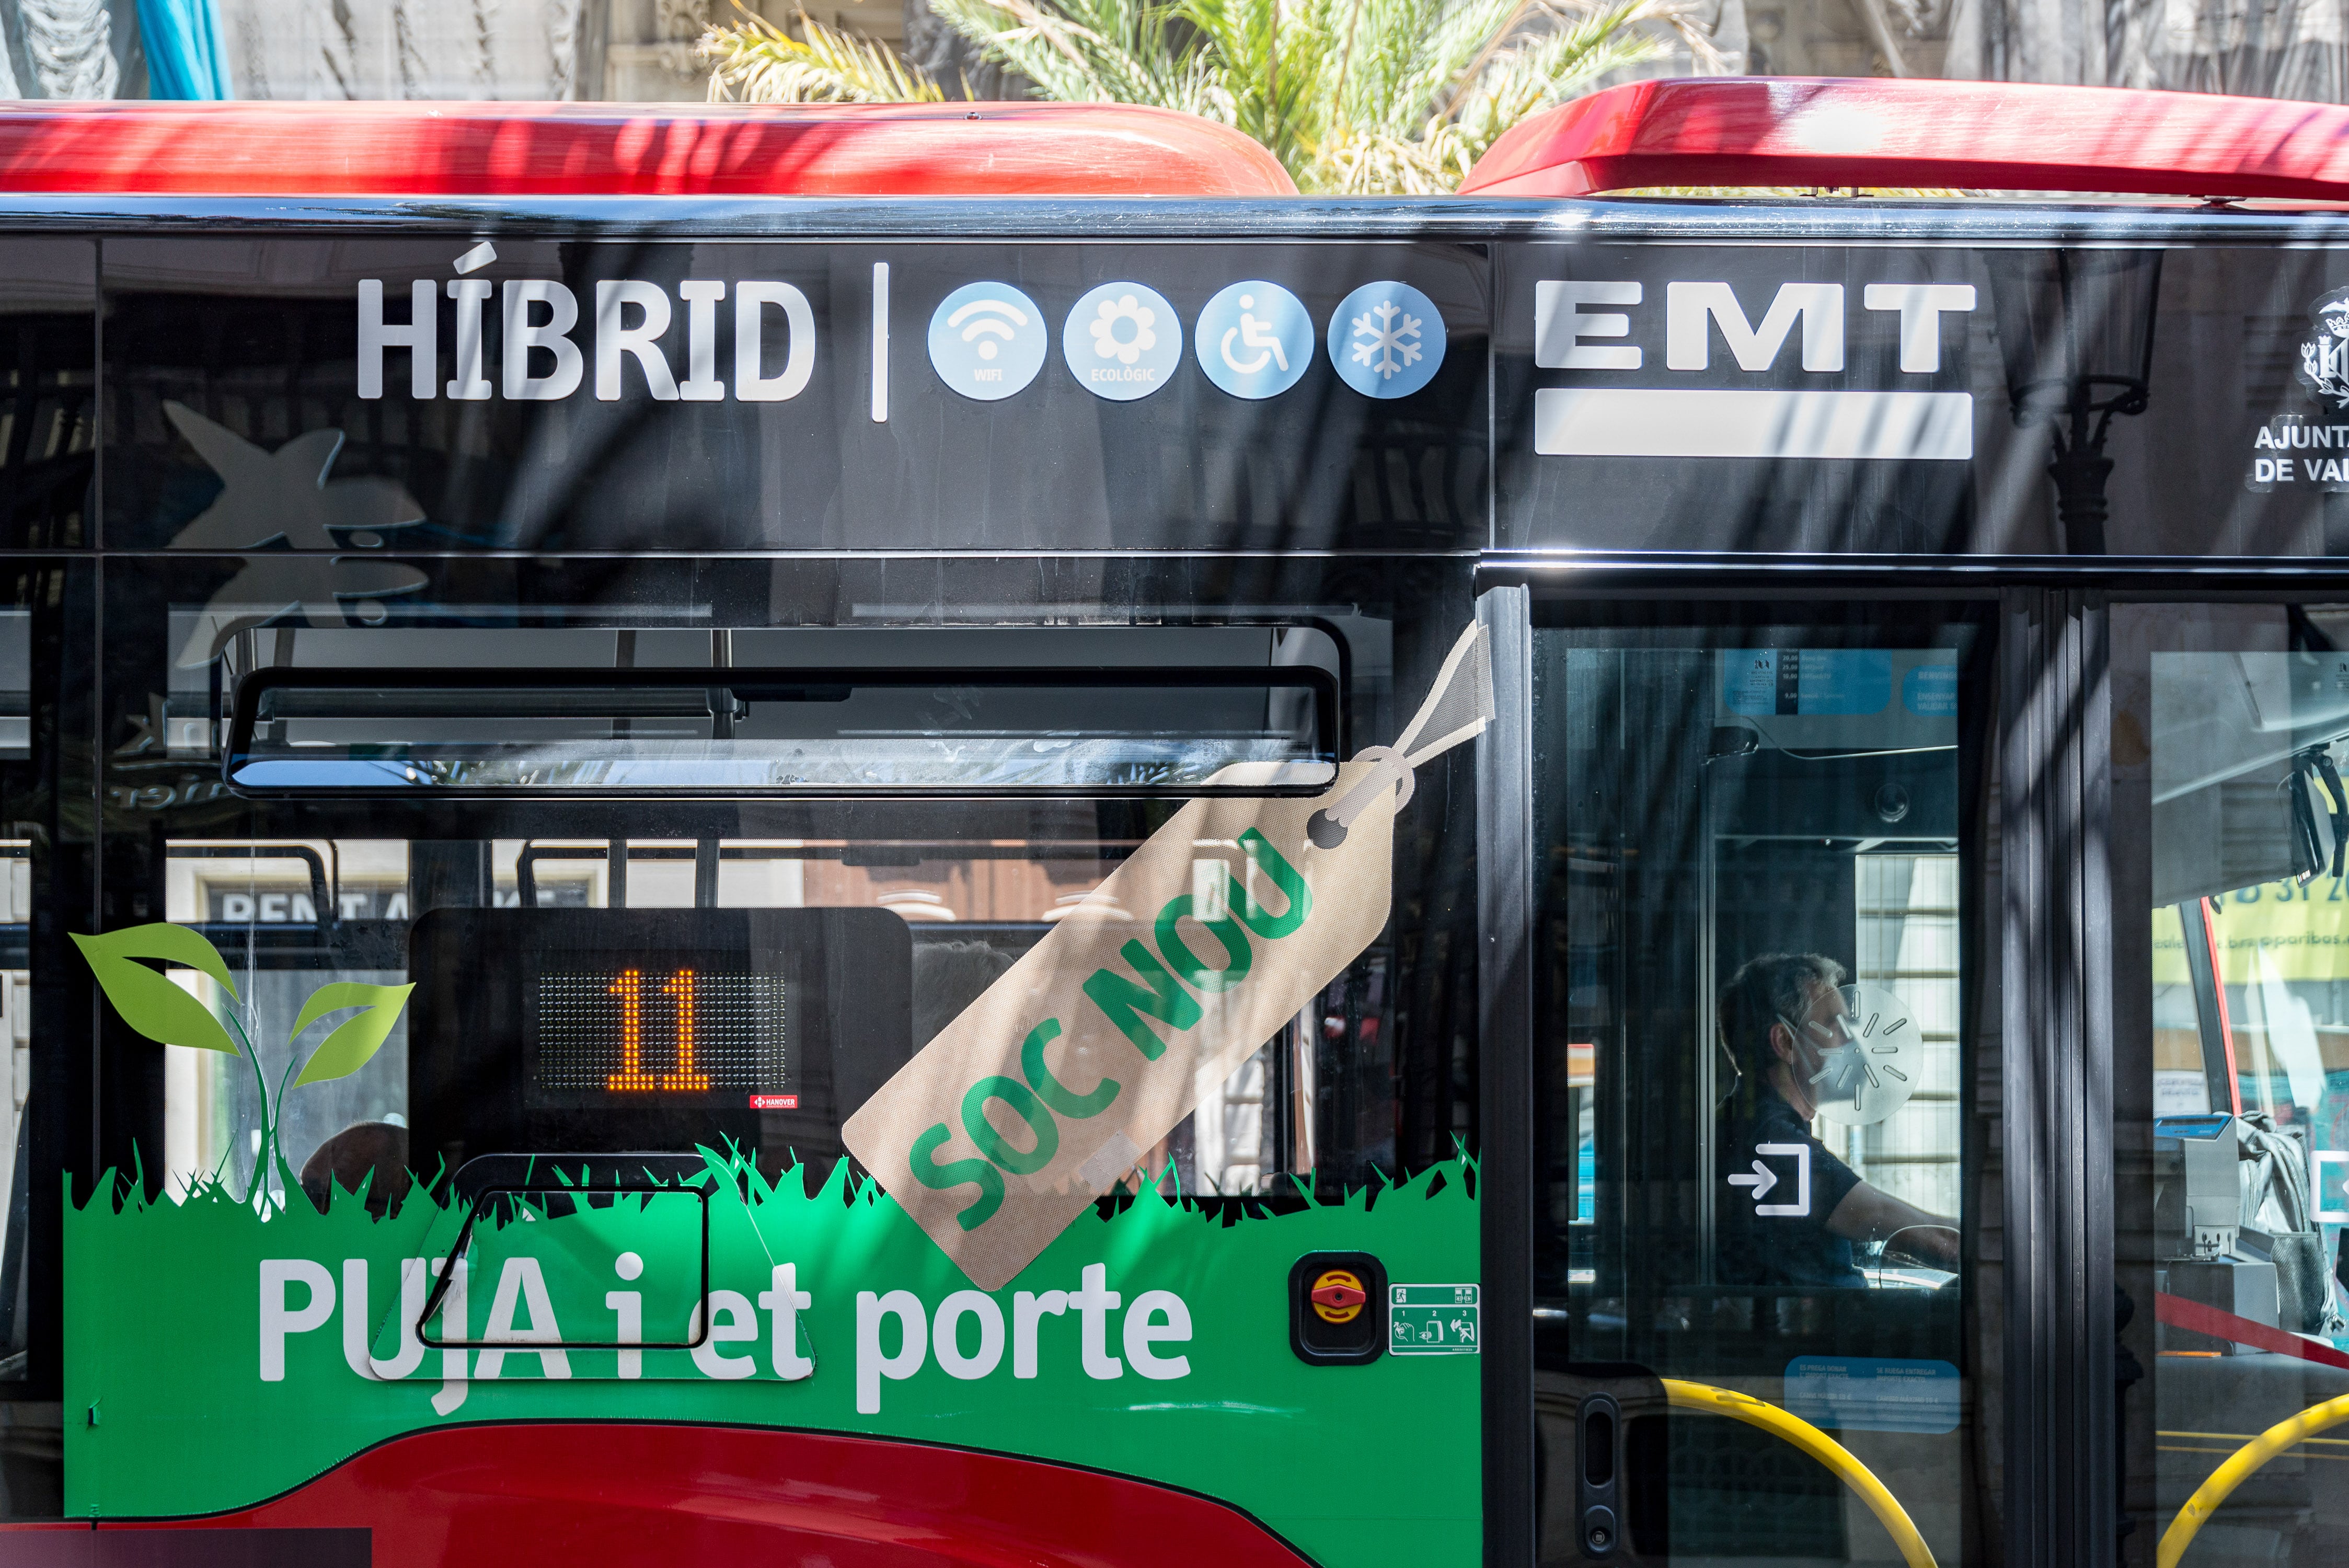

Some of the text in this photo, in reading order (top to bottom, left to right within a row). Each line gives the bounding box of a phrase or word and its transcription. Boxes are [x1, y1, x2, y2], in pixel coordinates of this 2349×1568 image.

[358, 241, 815, 401] HÍBRID
[1535, 281, 1977, 373] EMT
[974, 368, 1003, 382] WIFI
[1090, 366, 1156, 382] ECOLÒGIC
[2254, 425, 2349, 449] AJUNT
[2255, 458, 2294, 482] DE
[609, 970, 709, 1090] 11
[909, 826, 1313, 1231] SOC NOU
[259, 1251, 1193, 1416] PUJA i et porte
